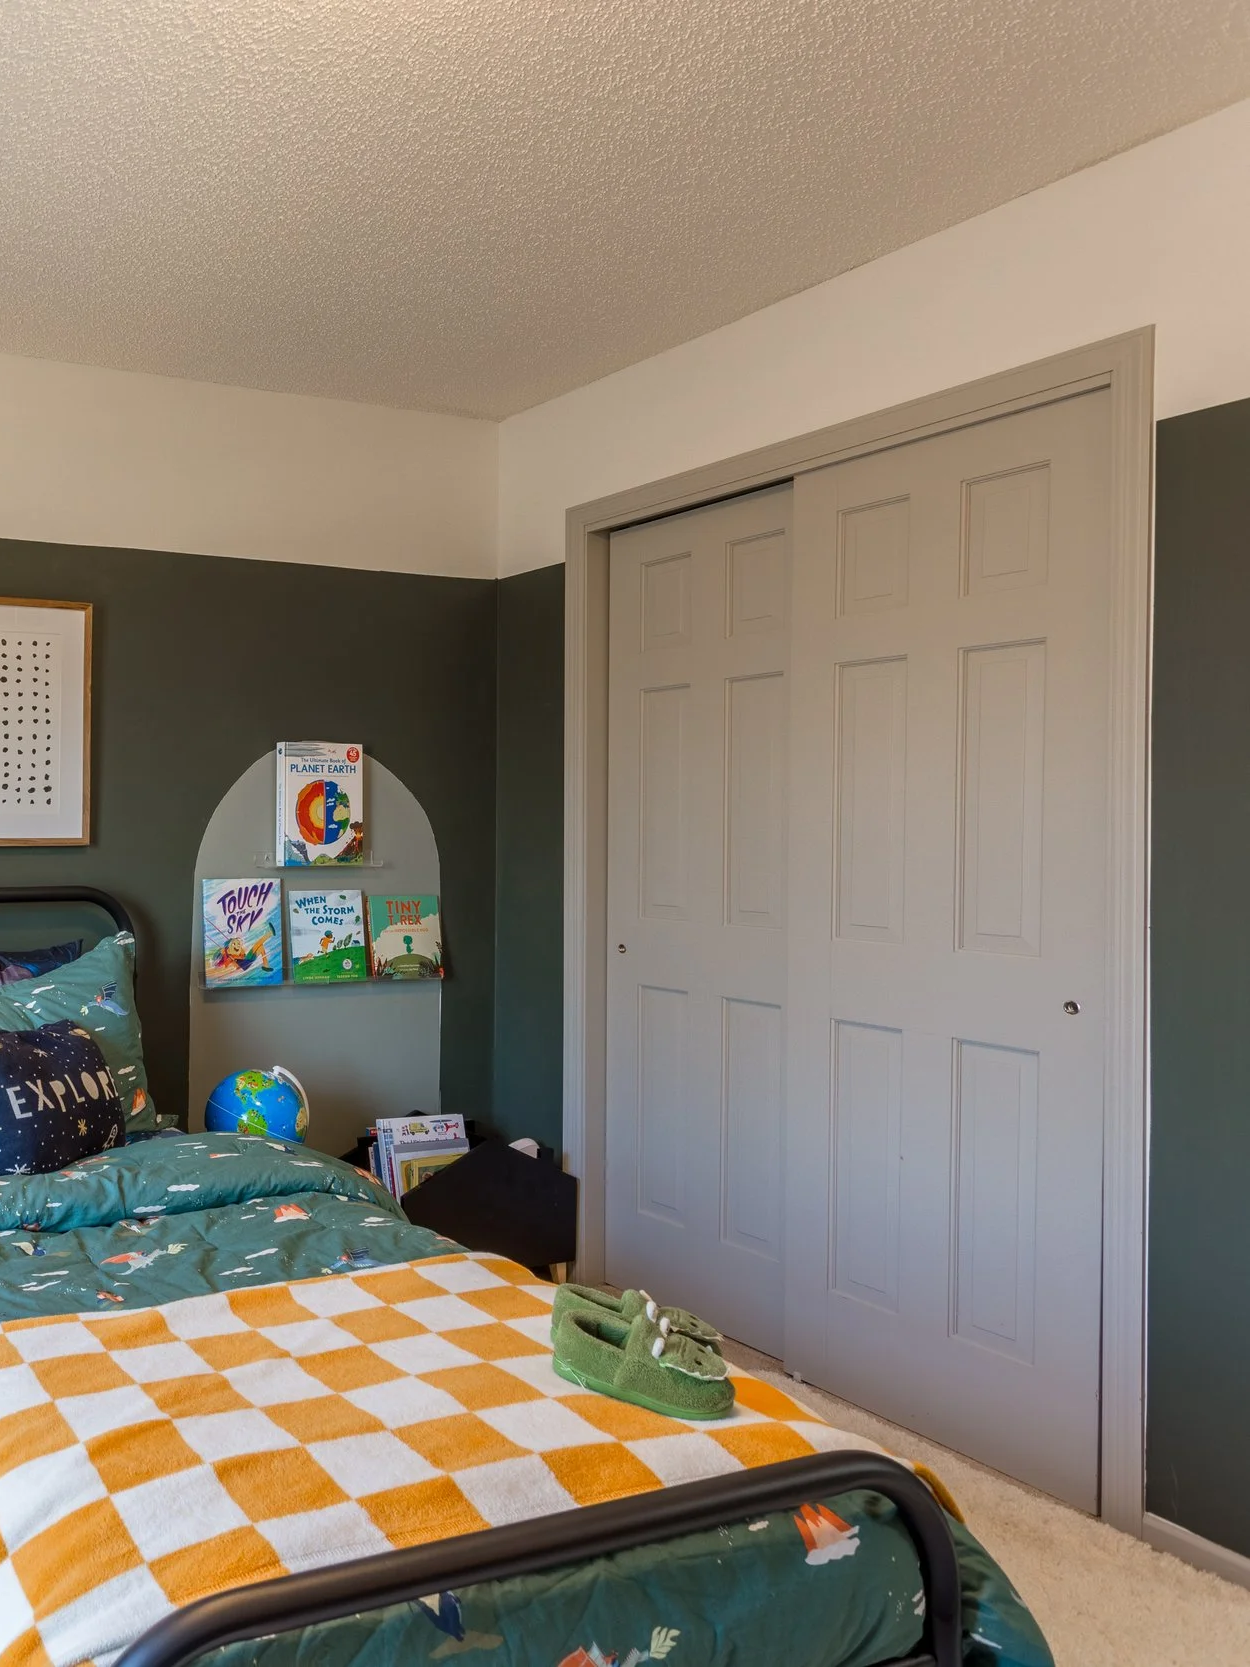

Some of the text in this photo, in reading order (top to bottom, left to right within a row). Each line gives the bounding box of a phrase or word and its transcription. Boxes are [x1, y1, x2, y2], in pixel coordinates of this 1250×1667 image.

[290, 764, 356, 773] PLANET EARTH
[217, 882, 273, 916] TOUCH
[295, 896, 327, 909] WHEN
[304, 904, 355, 915] THE STORM
[386, 900, 421, 914] TINY
[227, 908, 263, 934] SKY
[311, 916, 344, 926] COMES
[400, 915, 422, 925] REX
